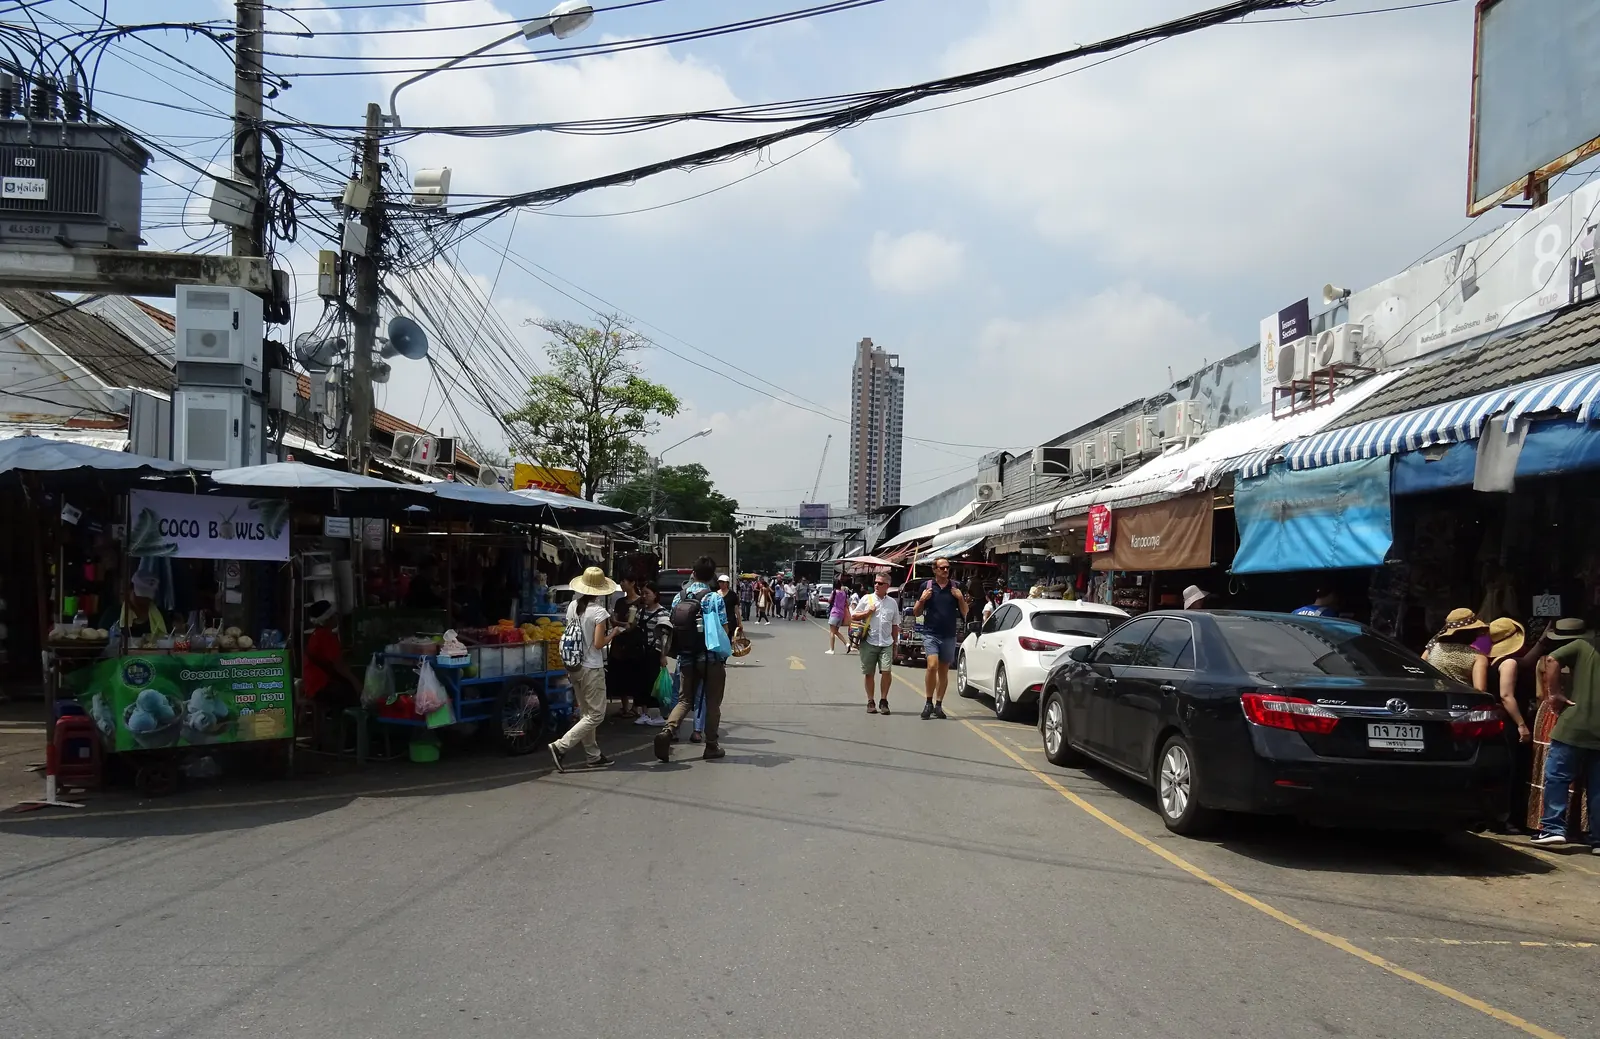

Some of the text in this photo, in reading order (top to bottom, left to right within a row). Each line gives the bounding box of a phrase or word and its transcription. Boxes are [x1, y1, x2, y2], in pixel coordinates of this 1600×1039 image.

[16, 158, 35, 167] 500
[1531, 223, 1562, 293] 8
[1538, 292, 1559, 307] true
[1281, 327, 1297, 340] Section
[158, 518, 200, 538] COCO
[180, 667, 283, 680] Coconut Icecream
[235, 692, 285, 703] หอม หวาน
[1373, 725, 1421, 738] กจ 7317
